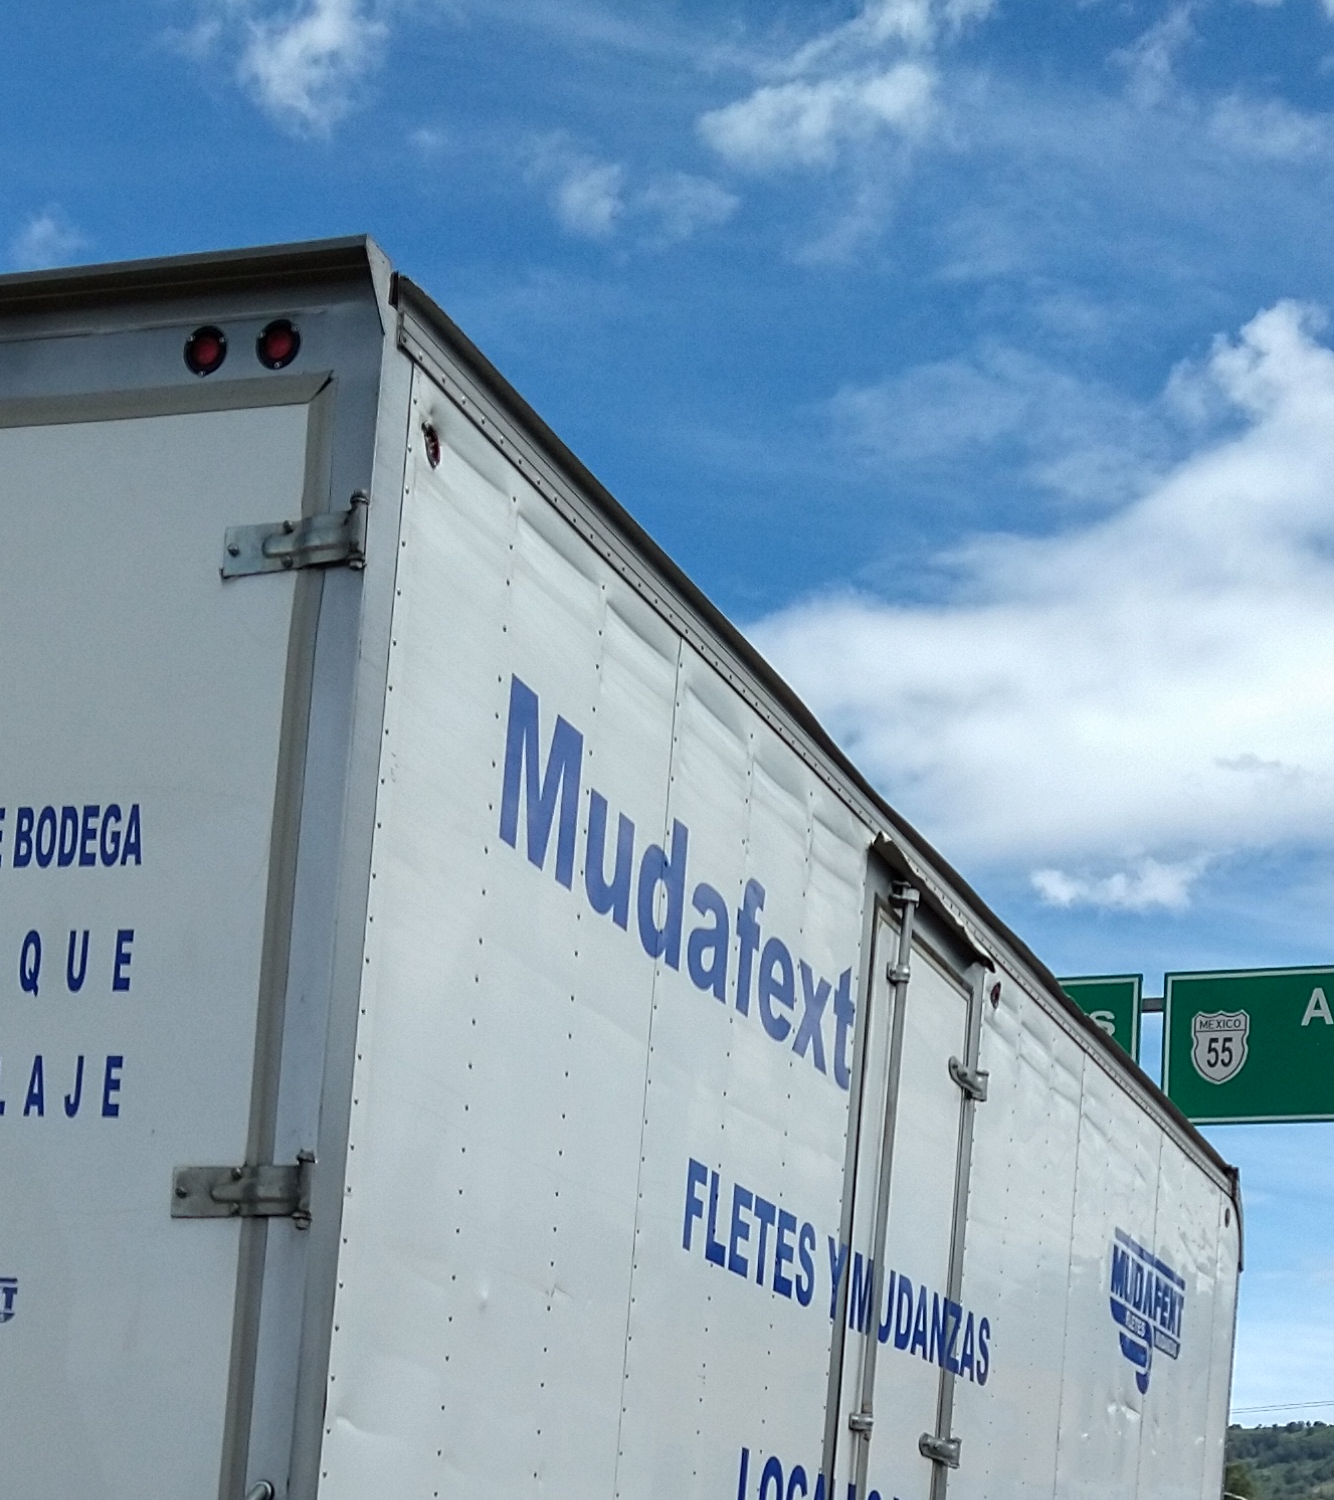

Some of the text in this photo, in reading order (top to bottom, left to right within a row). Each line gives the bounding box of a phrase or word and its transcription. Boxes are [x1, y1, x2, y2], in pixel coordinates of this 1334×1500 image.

[12, 803, 142, 869] BODEGA
[499, 672, 855, 1092] Mudafext
[1199, 1019, 1242, 1029] MEXICO
[1207, 1037, 1233, 1068] 55
[682, 1157, 991, 1387] FLETES Y MUDANZAS
[1110, 1243, 1185, 1339] MUDAFEXT
